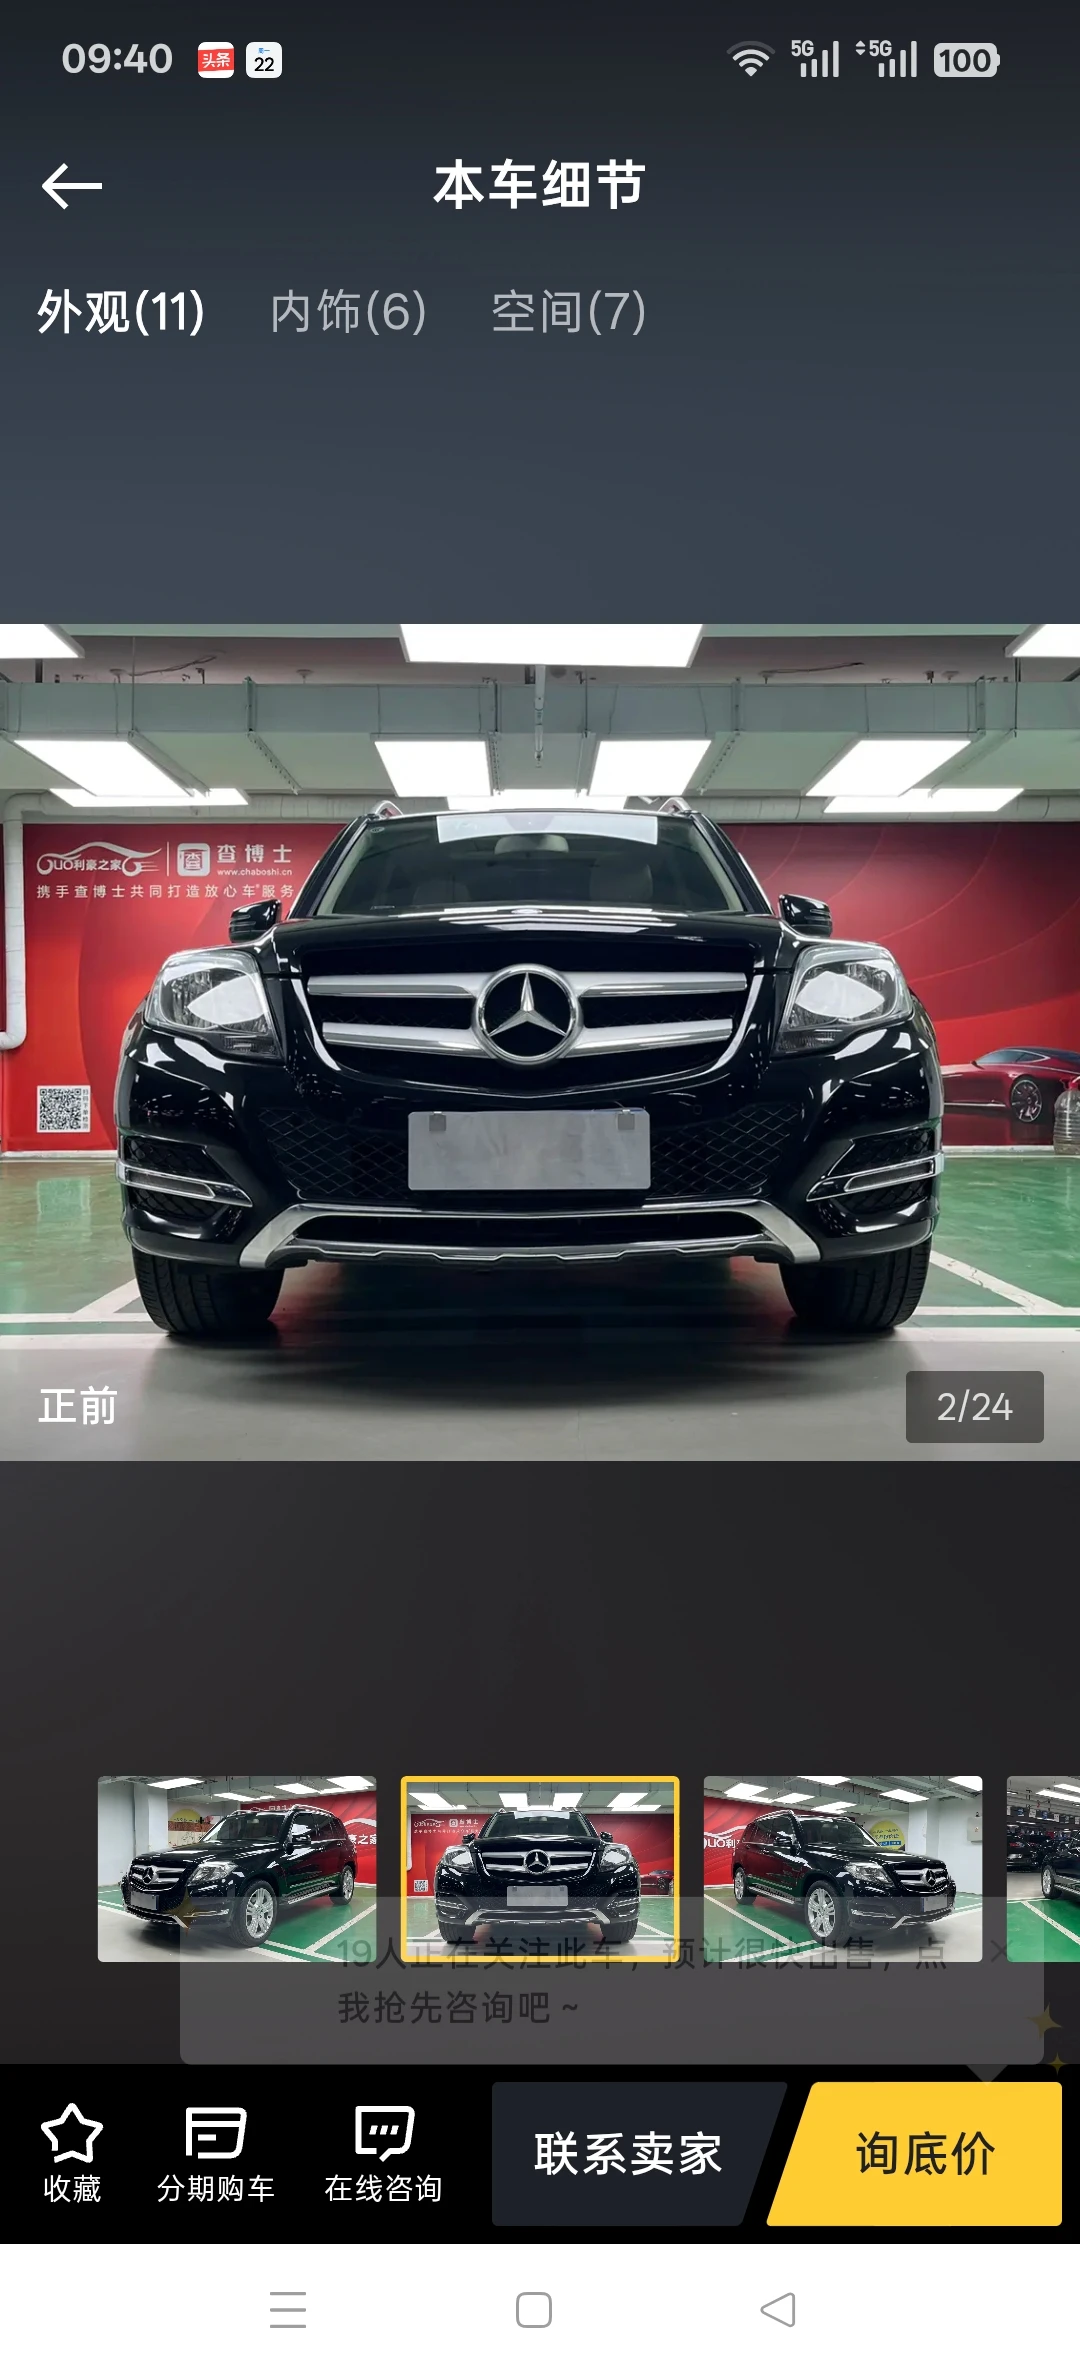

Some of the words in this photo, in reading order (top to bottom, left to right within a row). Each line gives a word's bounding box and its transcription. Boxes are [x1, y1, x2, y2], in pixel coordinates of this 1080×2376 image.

[62, 43, 172, 74] 09:40
[202, 52, 231, 68] 头条
[791, 40, 814, 57] 5G
[869, 40, 892, 57] 5G
[939, 49, 991, 72] 100
[254, 57, 274, 71] 22
[433, 158, 645, 210] 本车细节
[37, 289, 203, 336] 外观(11)
[273, 289, 425, 336] 内饰(6)
[493, 289, 644, 336] 空间(7)
[217, 844, 292, 863] 查博士
[217, 868, 293, 876] www.chaboshi.cn
[338, 1937, 947, 1971] 19人正在关注此车，预计很快出售，点
[534, 2131, 723, 2176] 联系卖家
[856, 2131, 996, 2176] 询底价
[43, 2173, 102, 2204] 收藏
[157, 2173, 275, 2203] 分期购车
[325, 2173, 442, 2203] 在线咨询
